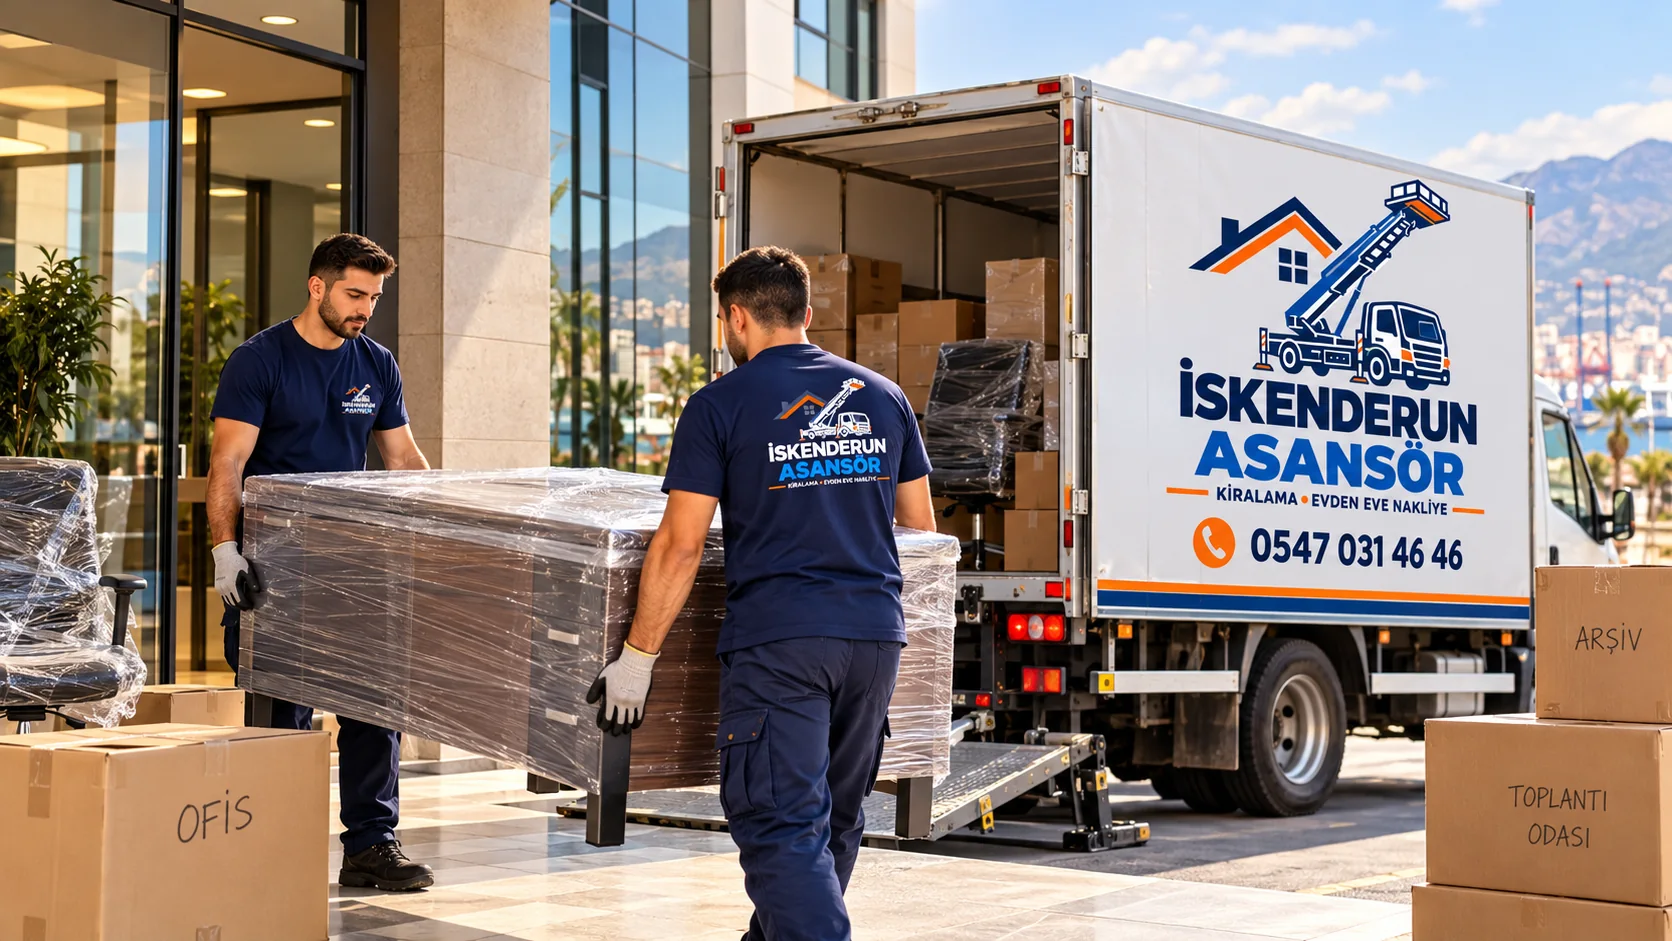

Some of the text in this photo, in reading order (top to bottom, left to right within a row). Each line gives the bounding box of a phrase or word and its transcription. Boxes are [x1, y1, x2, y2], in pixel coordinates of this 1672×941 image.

[1179, 357, 1478, 446] İSKENDERUN
[768, 438, 887, 462] İSKENDERUN
[1194, 430, 1465, 496] ASANSÖR
[779, 454, 881, 482] ASANSÖR
[1216, 484, 1448, 516] KİRALAMA EVDEN EVE NAKLİYE
[1250, 528, 1463, 571] 0547 031 46 46
[1575, 622, 1642, 655] ARŞİV
[1508, 784, 1608, 812] TOPLANTI
[177, 789, 253, 843] OFİS
[1528, 823, 1590, 849] ODASI
